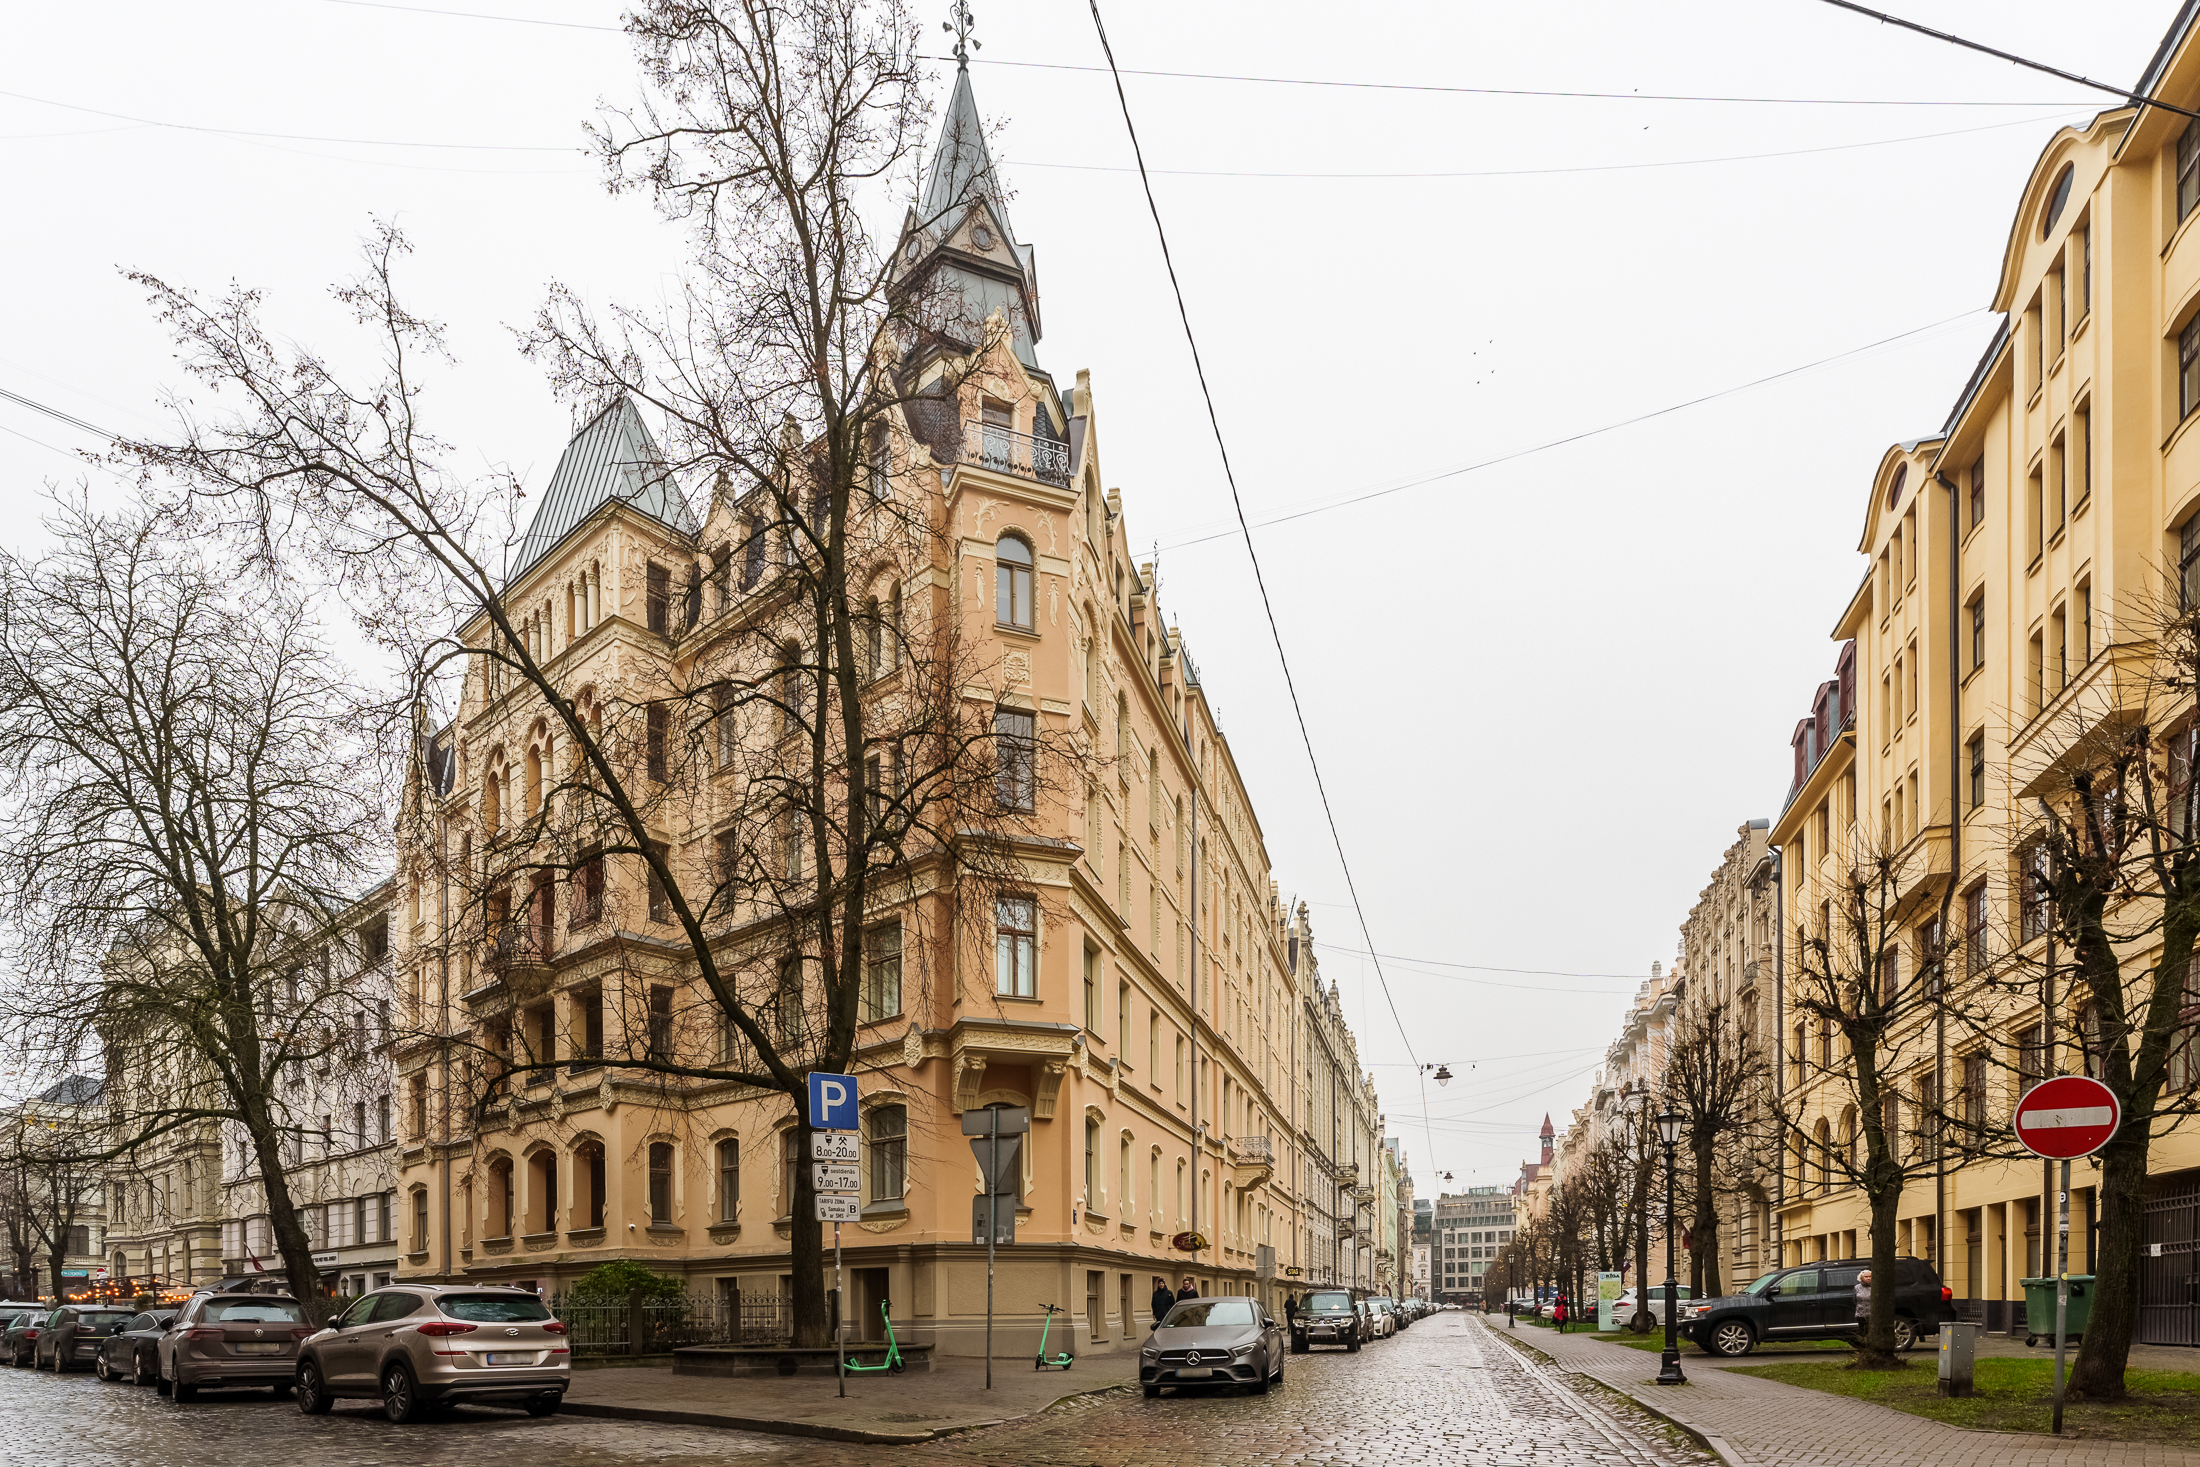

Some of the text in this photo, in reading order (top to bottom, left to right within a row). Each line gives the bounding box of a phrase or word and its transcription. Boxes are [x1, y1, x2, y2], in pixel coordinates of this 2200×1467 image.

[821, 1080, 847, 1122] P
[816, 1145, 857, 1158] 8.00-20.00
[817, 1176, 858, 1188] 9.00-17.00
[849, 1204, 857, 1214] B
